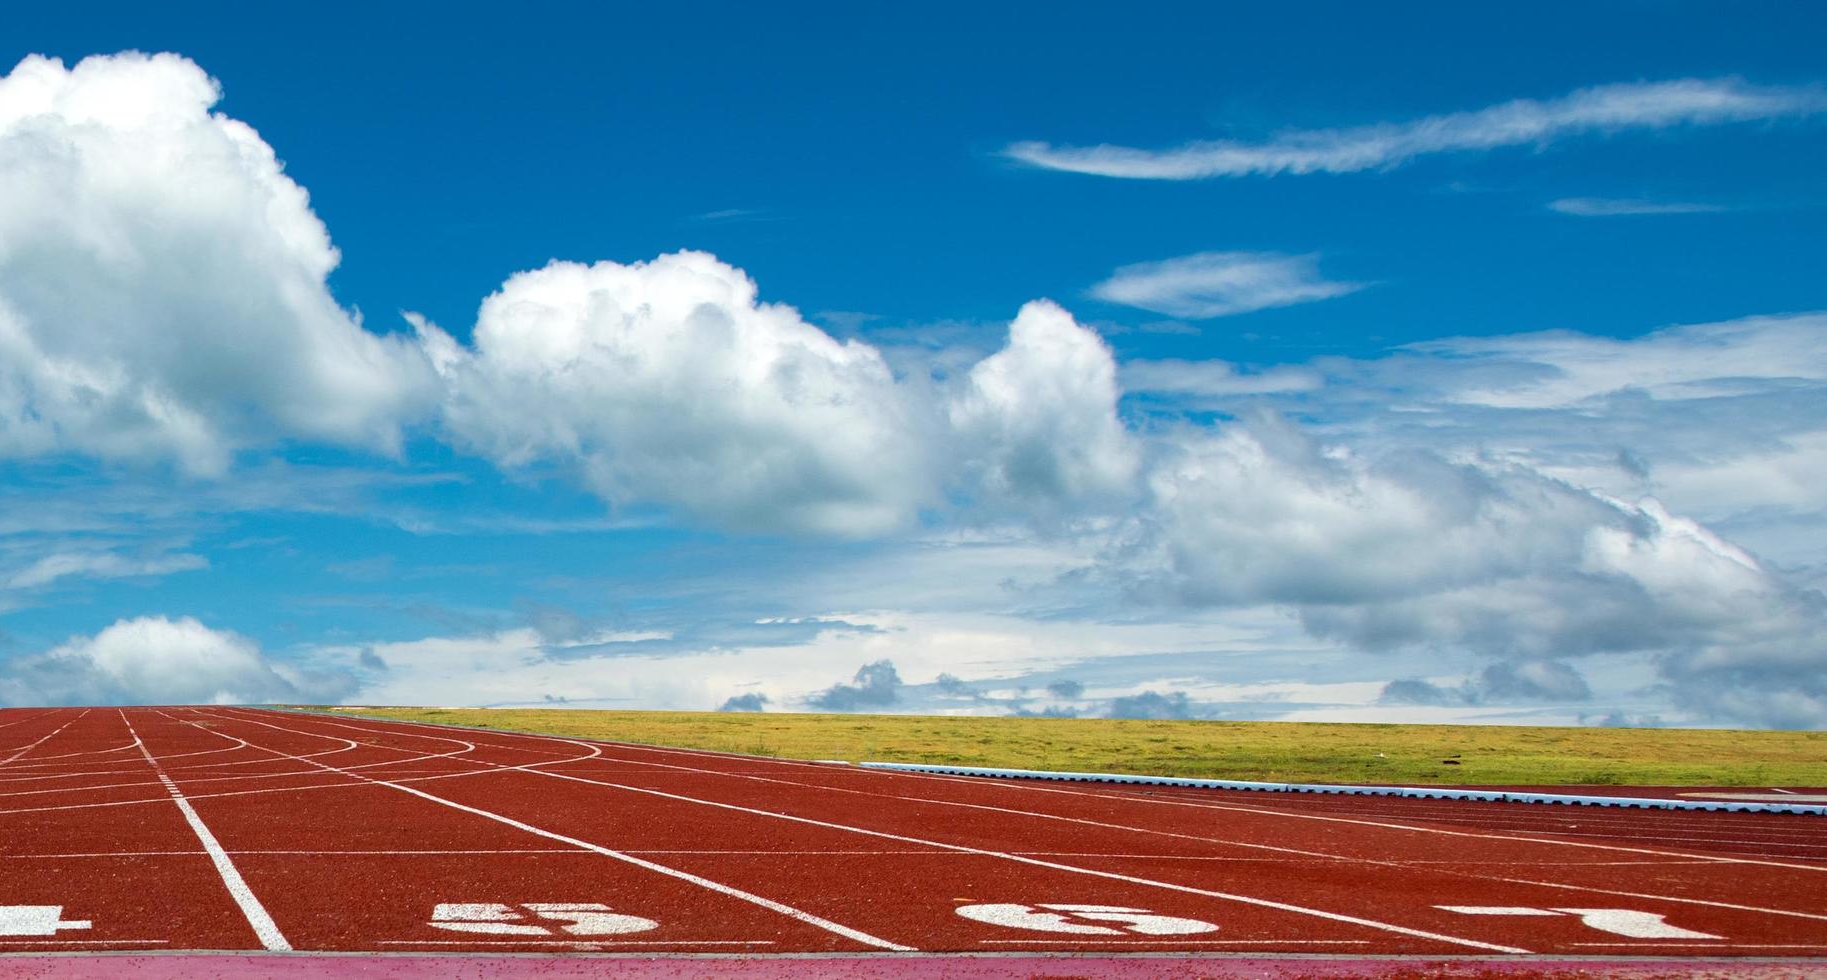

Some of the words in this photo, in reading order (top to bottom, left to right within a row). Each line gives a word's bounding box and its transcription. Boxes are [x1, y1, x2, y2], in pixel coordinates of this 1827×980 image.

[426, 902, 660, 936] 5
[954, 902, 1220, 936] 6
[1430, 904, 1730, 940] 7
